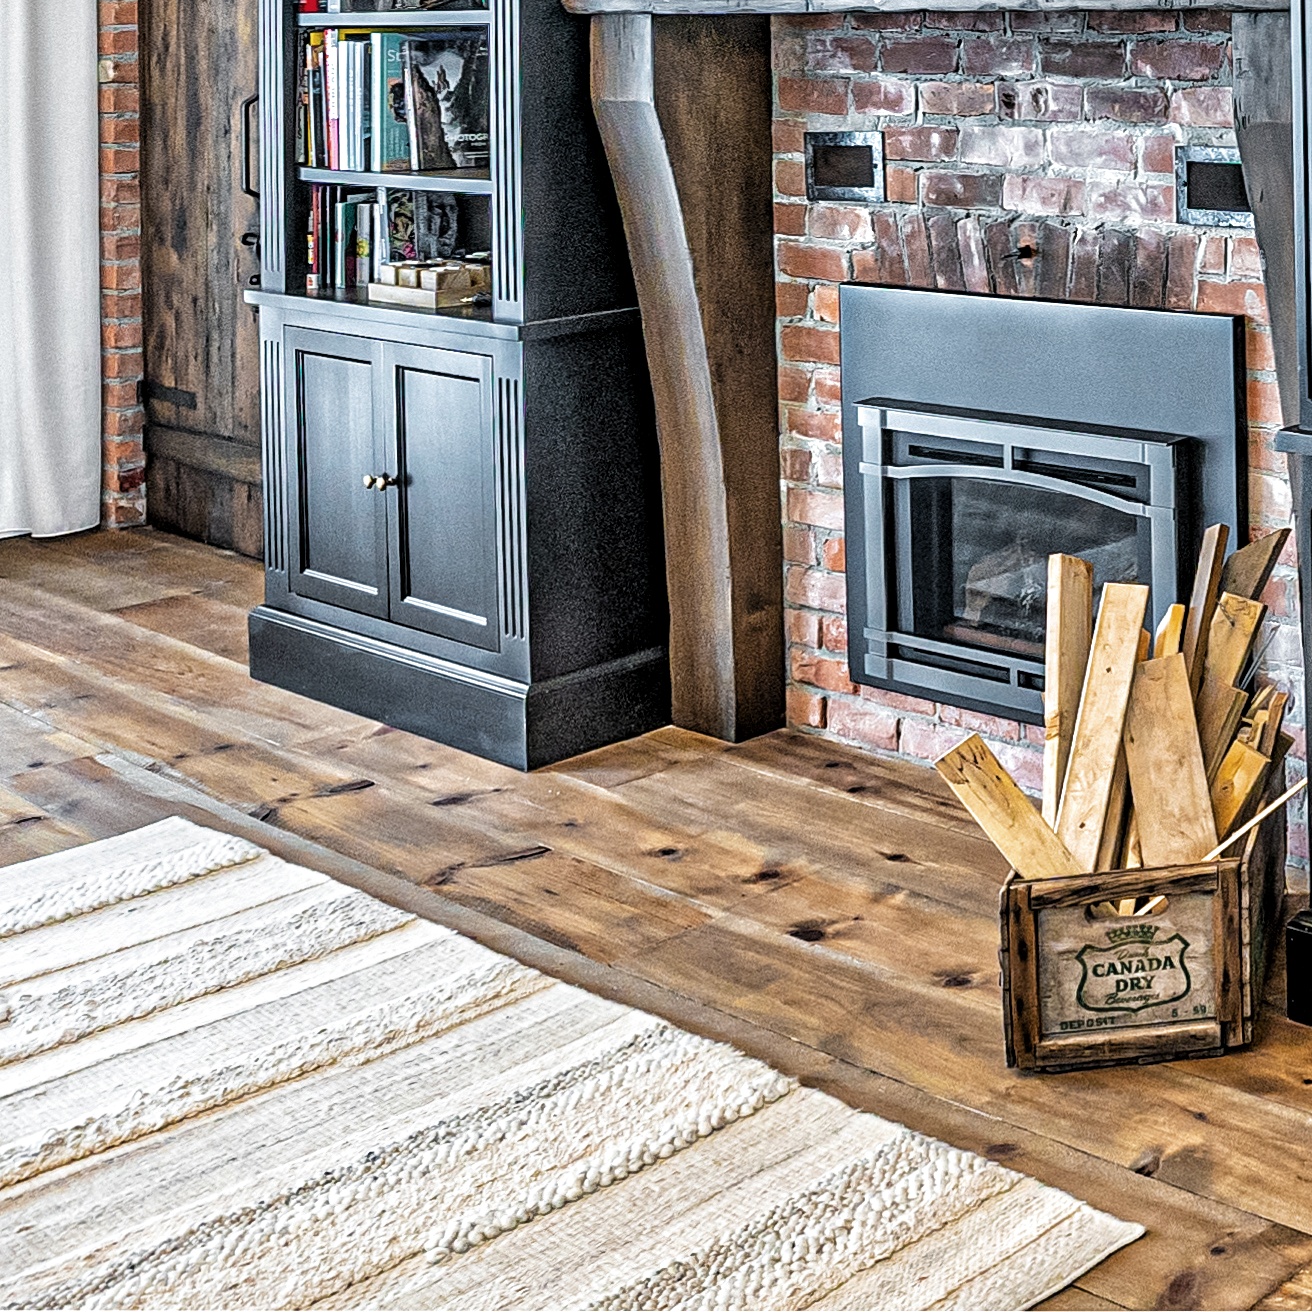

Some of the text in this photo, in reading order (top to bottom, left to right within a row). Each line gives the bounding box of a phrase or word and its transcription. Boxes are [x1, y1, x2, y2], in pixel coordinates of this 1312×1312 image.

[1092, 956, 1176, 977] CANADA
[1115, 976, 1155, 992] DRY
[1060, 1016, 1116, 1030] DEPOSIT
